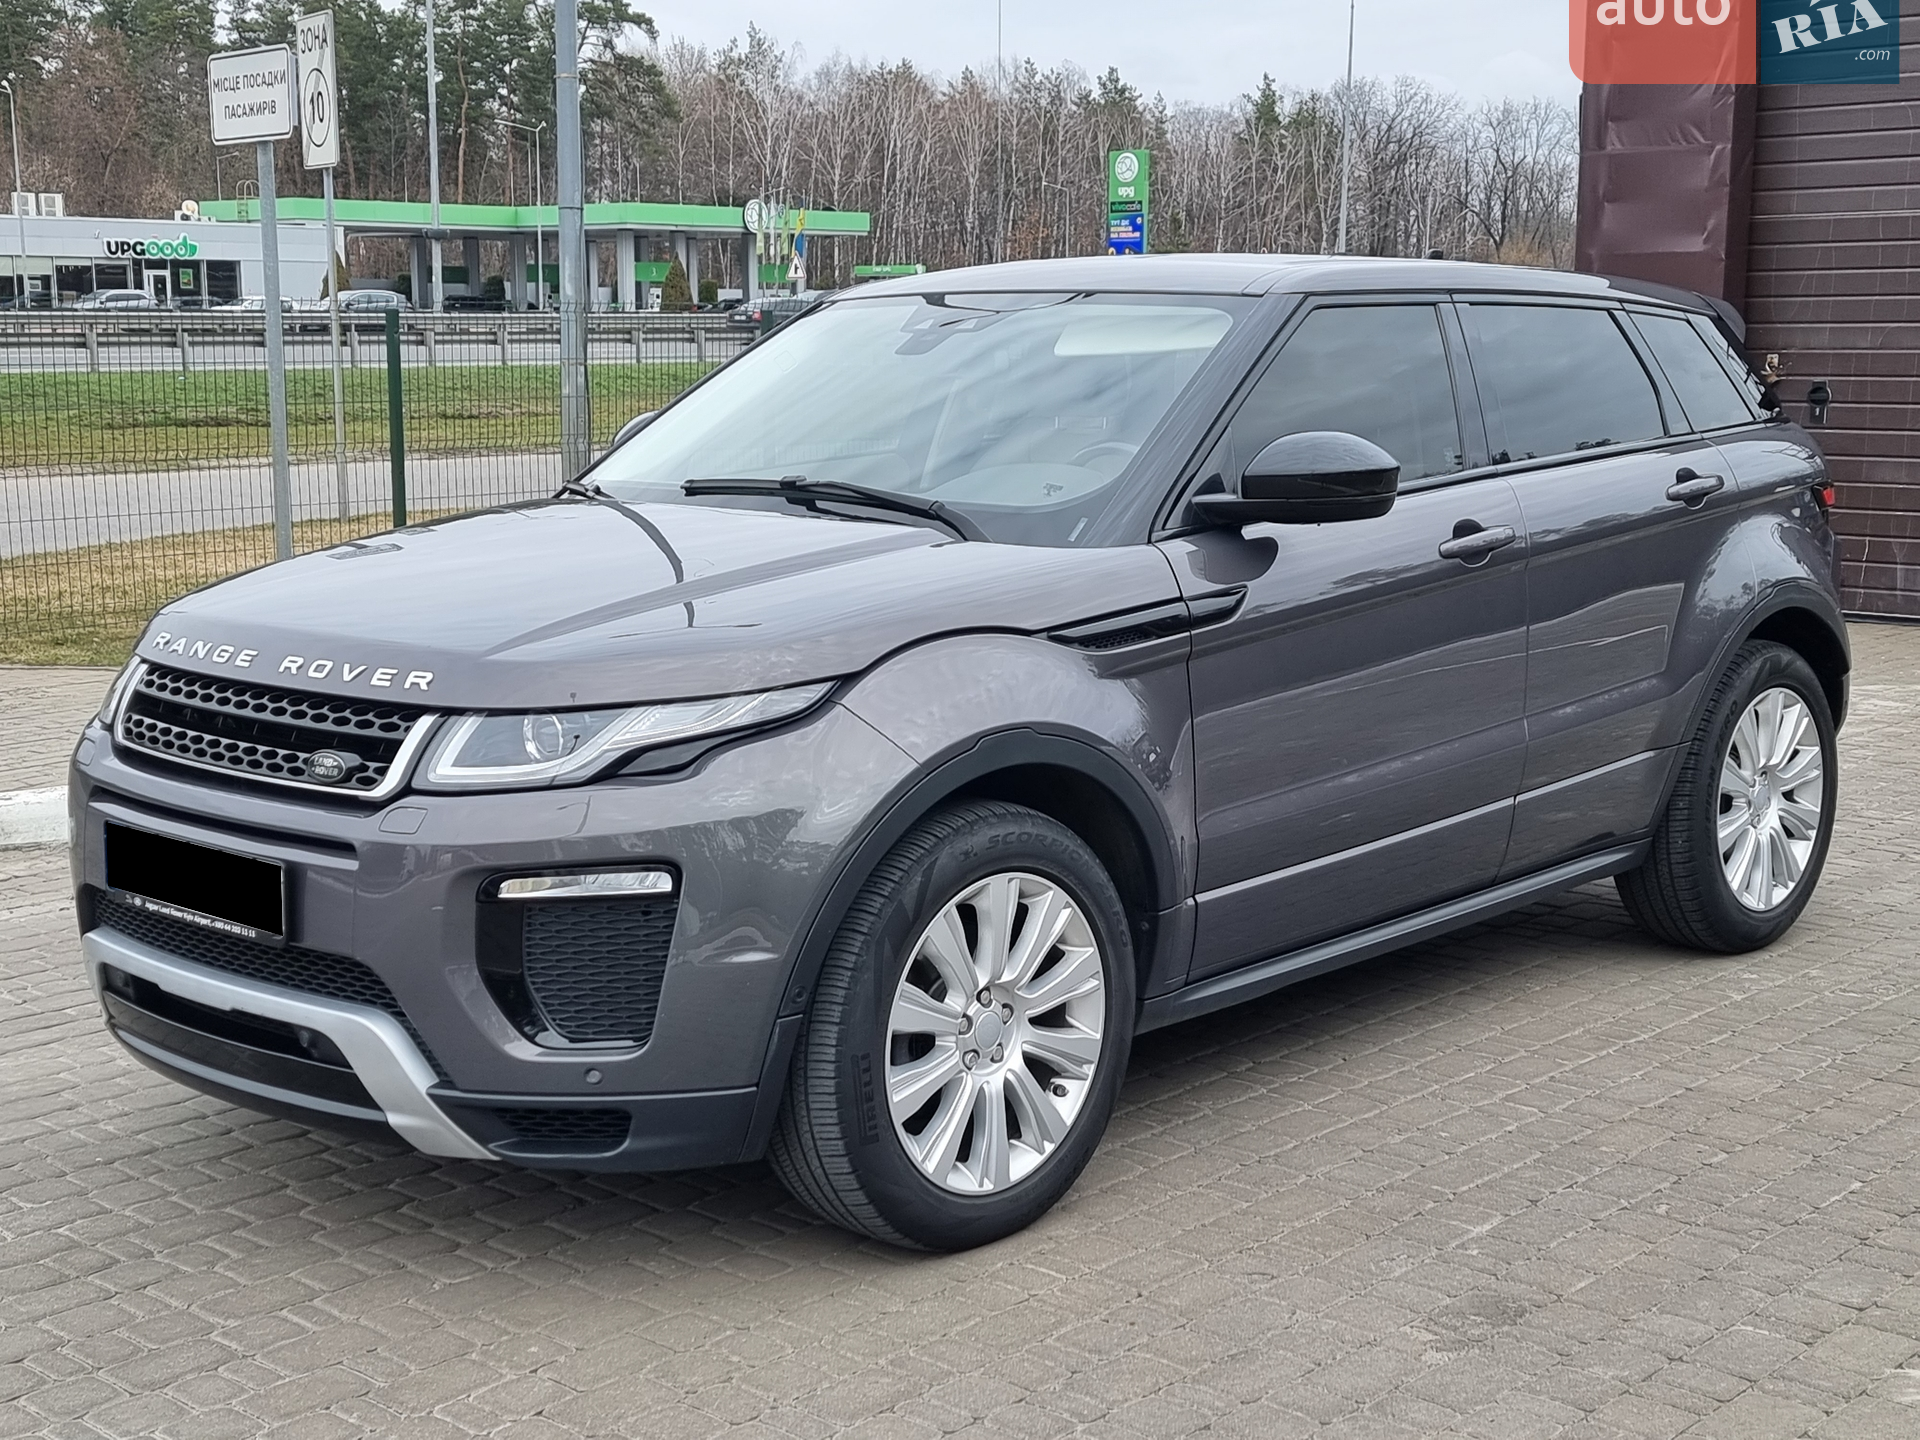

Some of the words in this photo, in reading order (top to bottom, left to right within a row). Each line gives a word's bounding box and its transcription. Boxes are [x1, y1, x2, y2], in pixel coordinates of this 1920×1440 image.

[300, 23, 329, 54] ЗОНА
[213, 75, 241, 94] МІСЦЕ
[243, 69, 286, 89] ПОСАДКИ
[224, 100, 277, 120] ПАСАЖИРІВ
[309, 91, 325, 125] 10
[152, 631, 259, 667] RANGE
[278, 655, 435, 691] ROVER
[313, 756, 334, 767] LAND
[314, 766, 339, 777] ROVER
